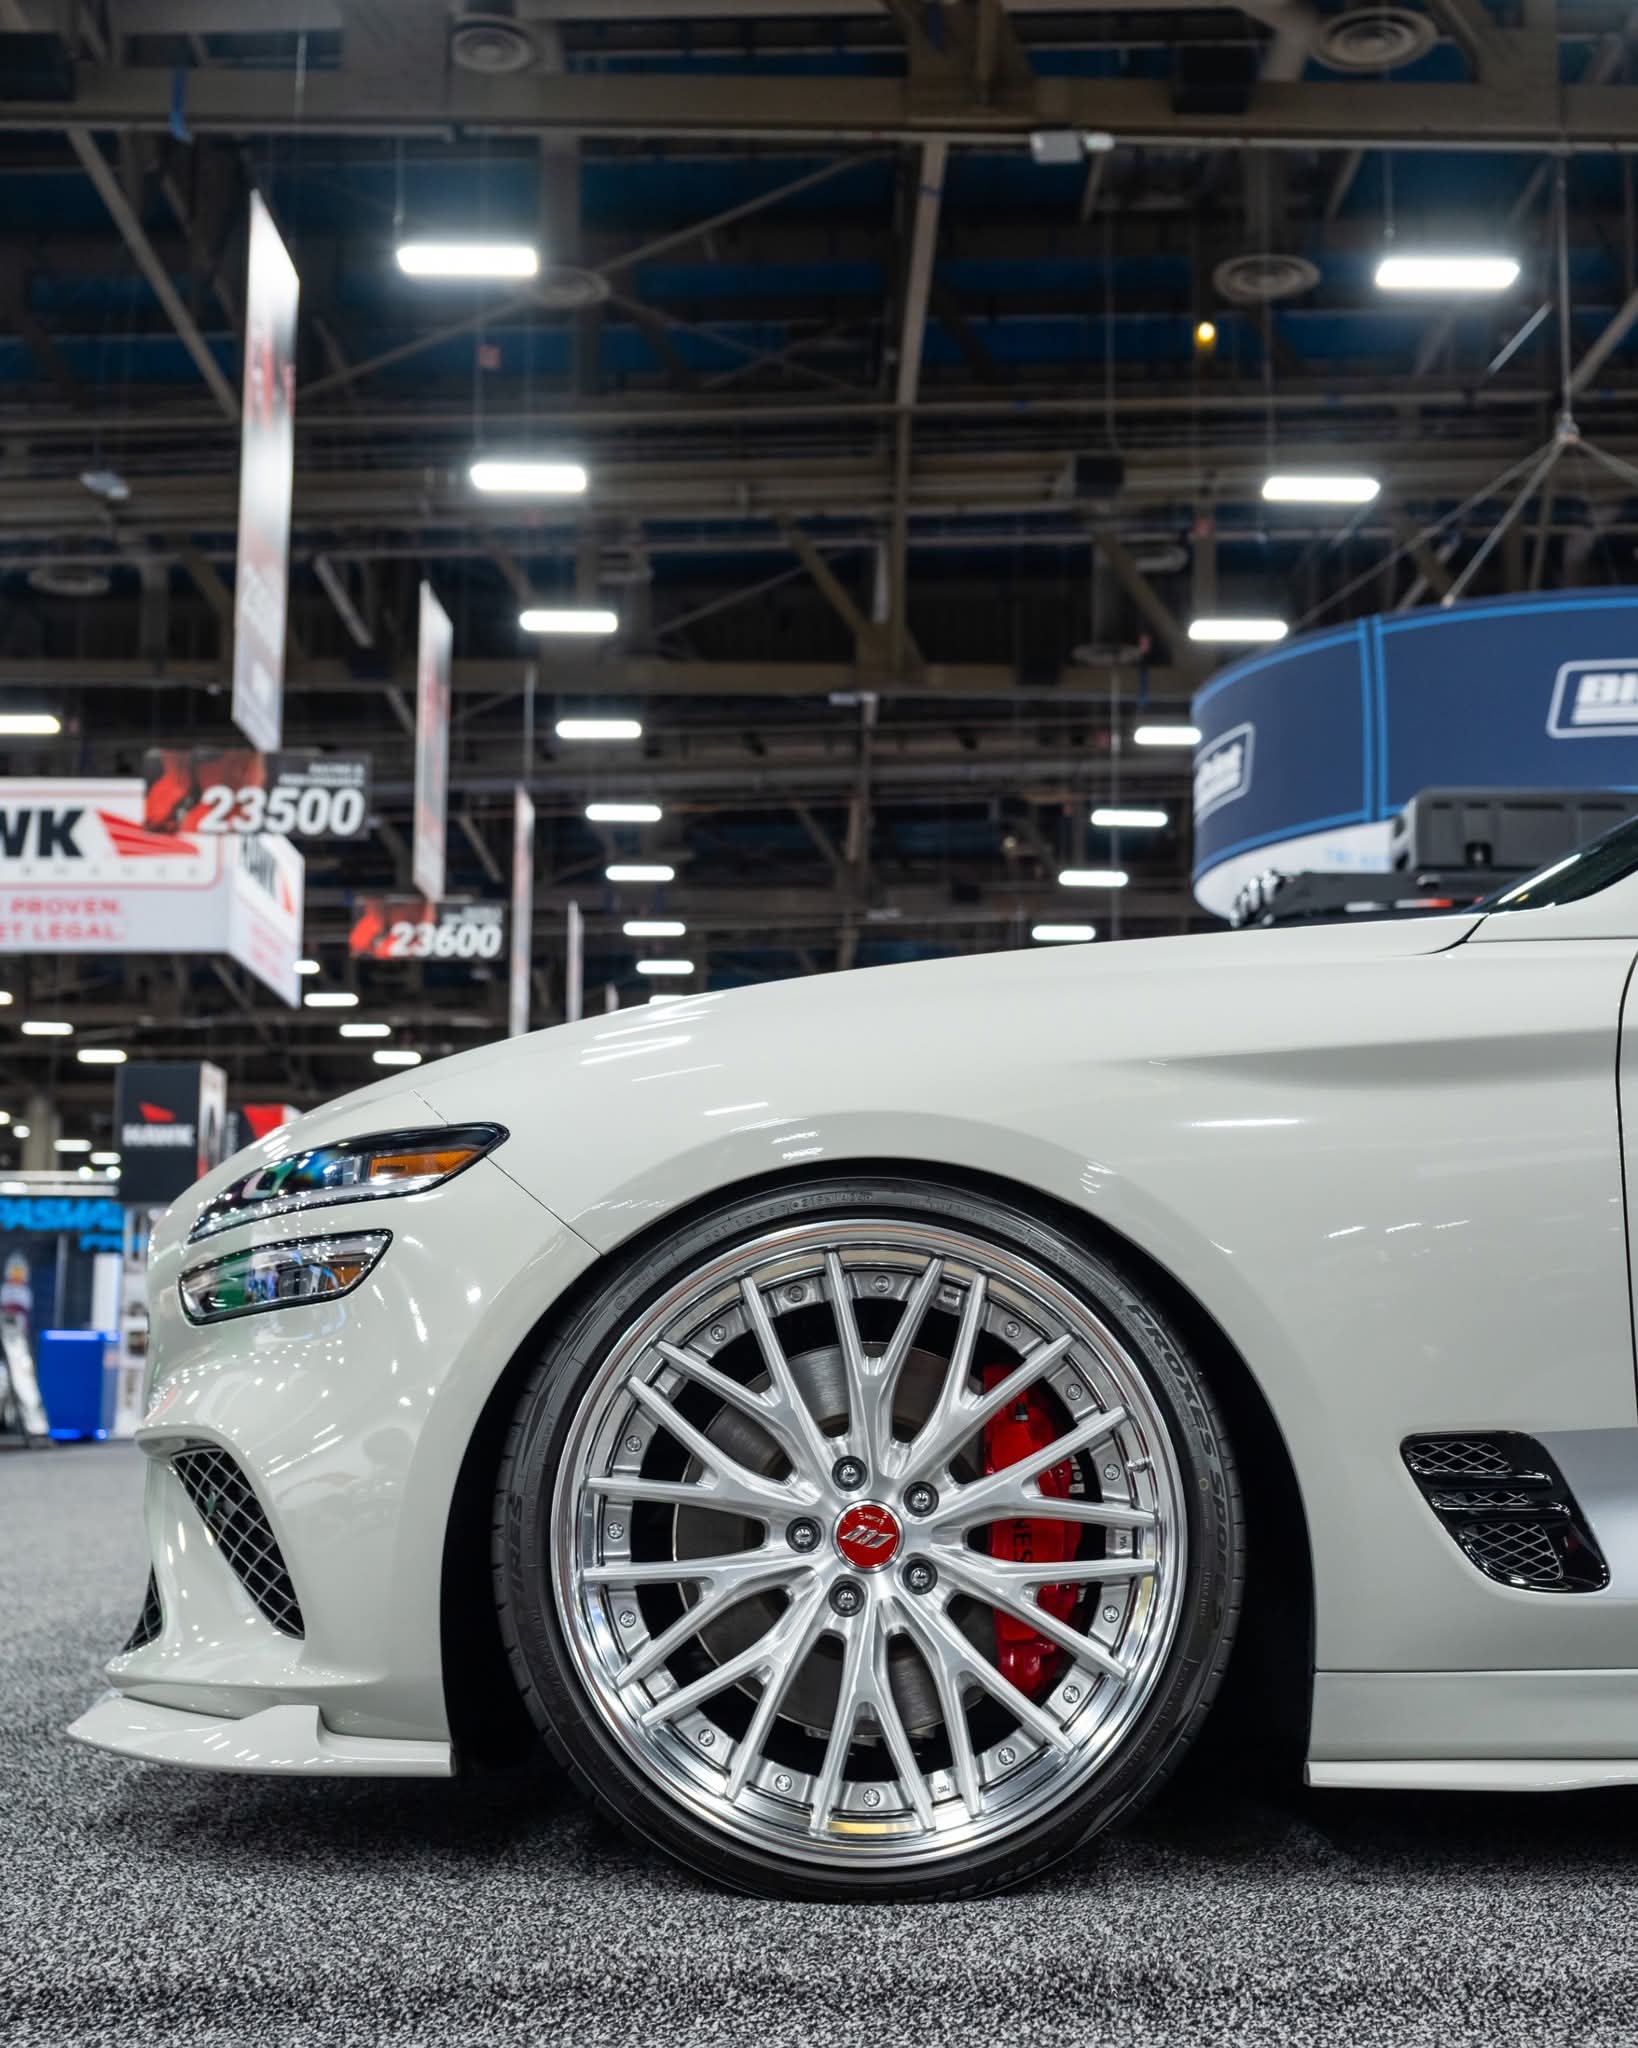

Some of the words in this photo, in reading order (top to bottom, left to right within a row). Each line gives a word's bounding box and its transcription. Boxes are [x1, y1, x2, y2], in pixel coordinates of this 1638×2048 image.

[196, 785, 365, 835] 23500
[389, 921, 503, 957] 23600
[1126, 1304, 1215, 1457] PROXES
